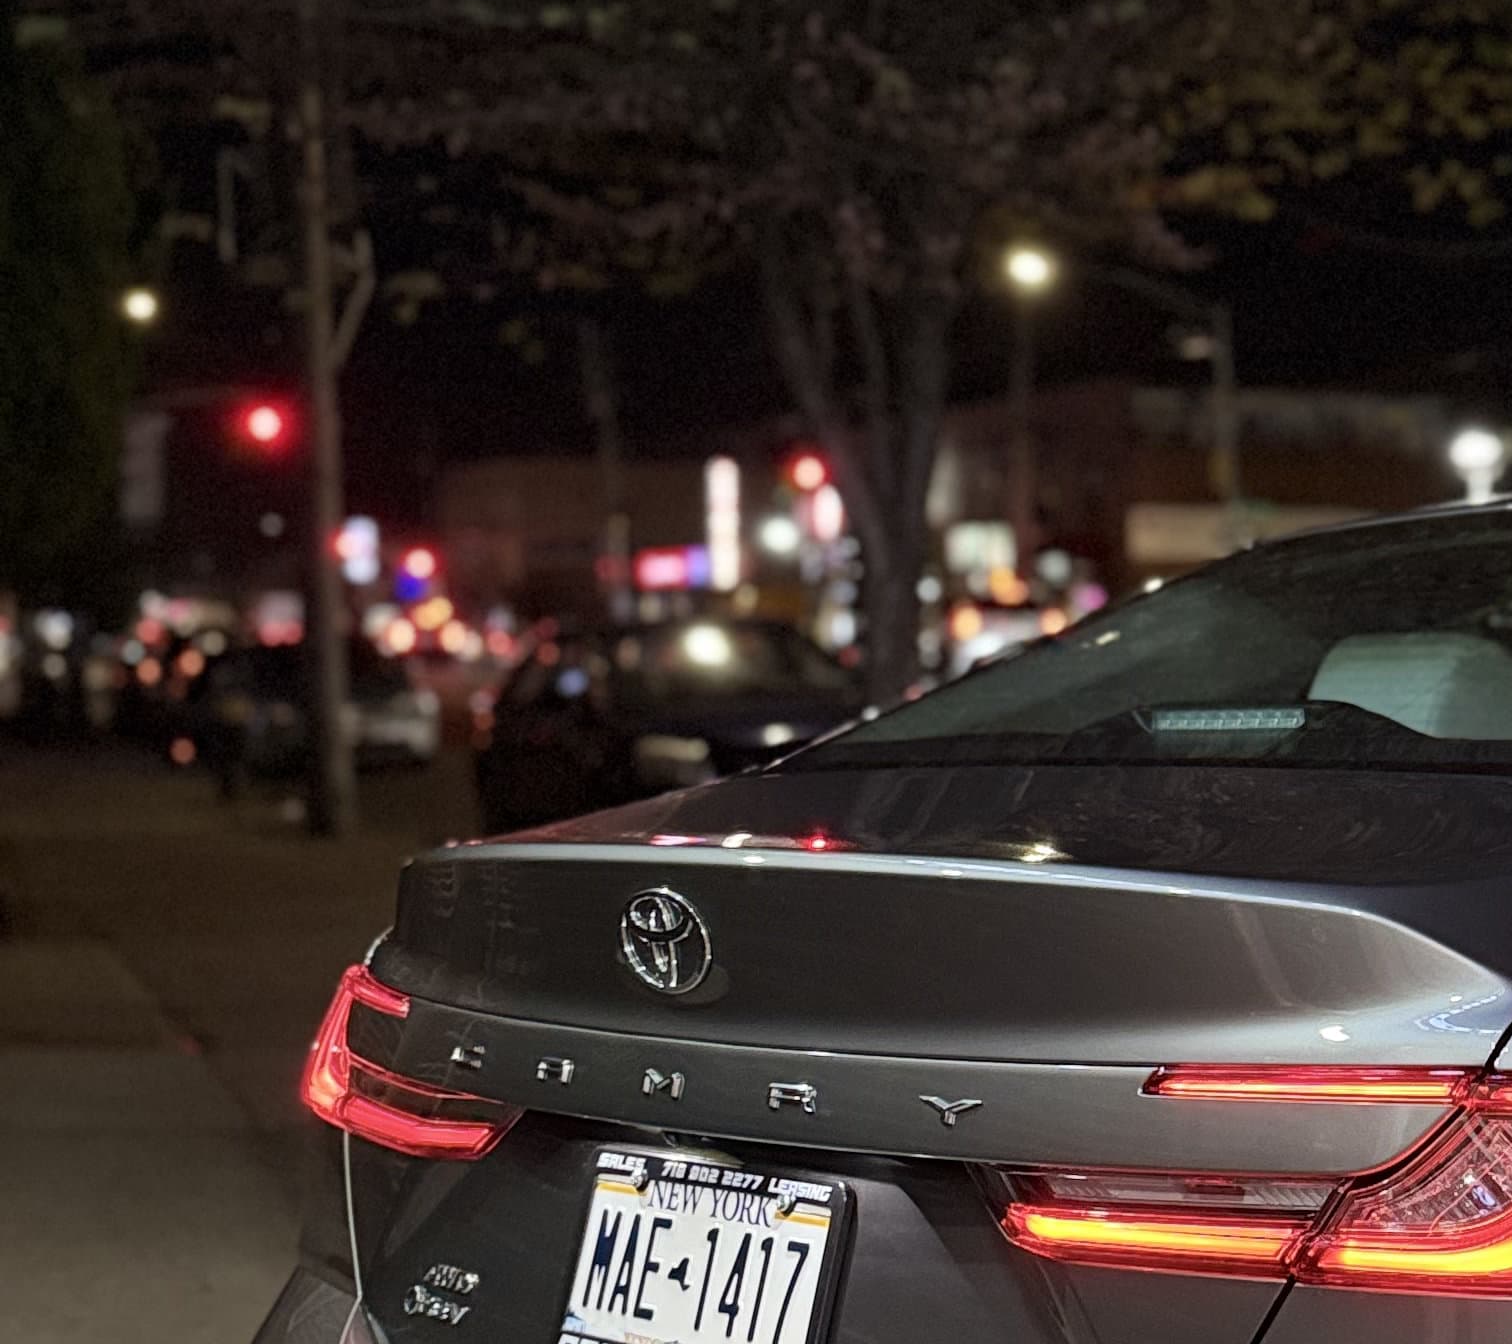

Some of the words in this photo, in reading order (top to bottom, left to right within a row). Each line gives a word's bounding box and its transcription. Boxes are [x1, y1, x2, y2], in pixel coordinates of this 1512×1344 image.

[450, 1044, 984, 1126] CAMRY
[597, 1152, 646, 1173] SALES
[661, 1161, 688, 1179] 718
[721, 1170, 765, 1190] 2277
[768, 1177, 833, 1203] LEASING
[649, 1179, 702, 1215] NEW
[709, 1189, 772, 1227] YORK
